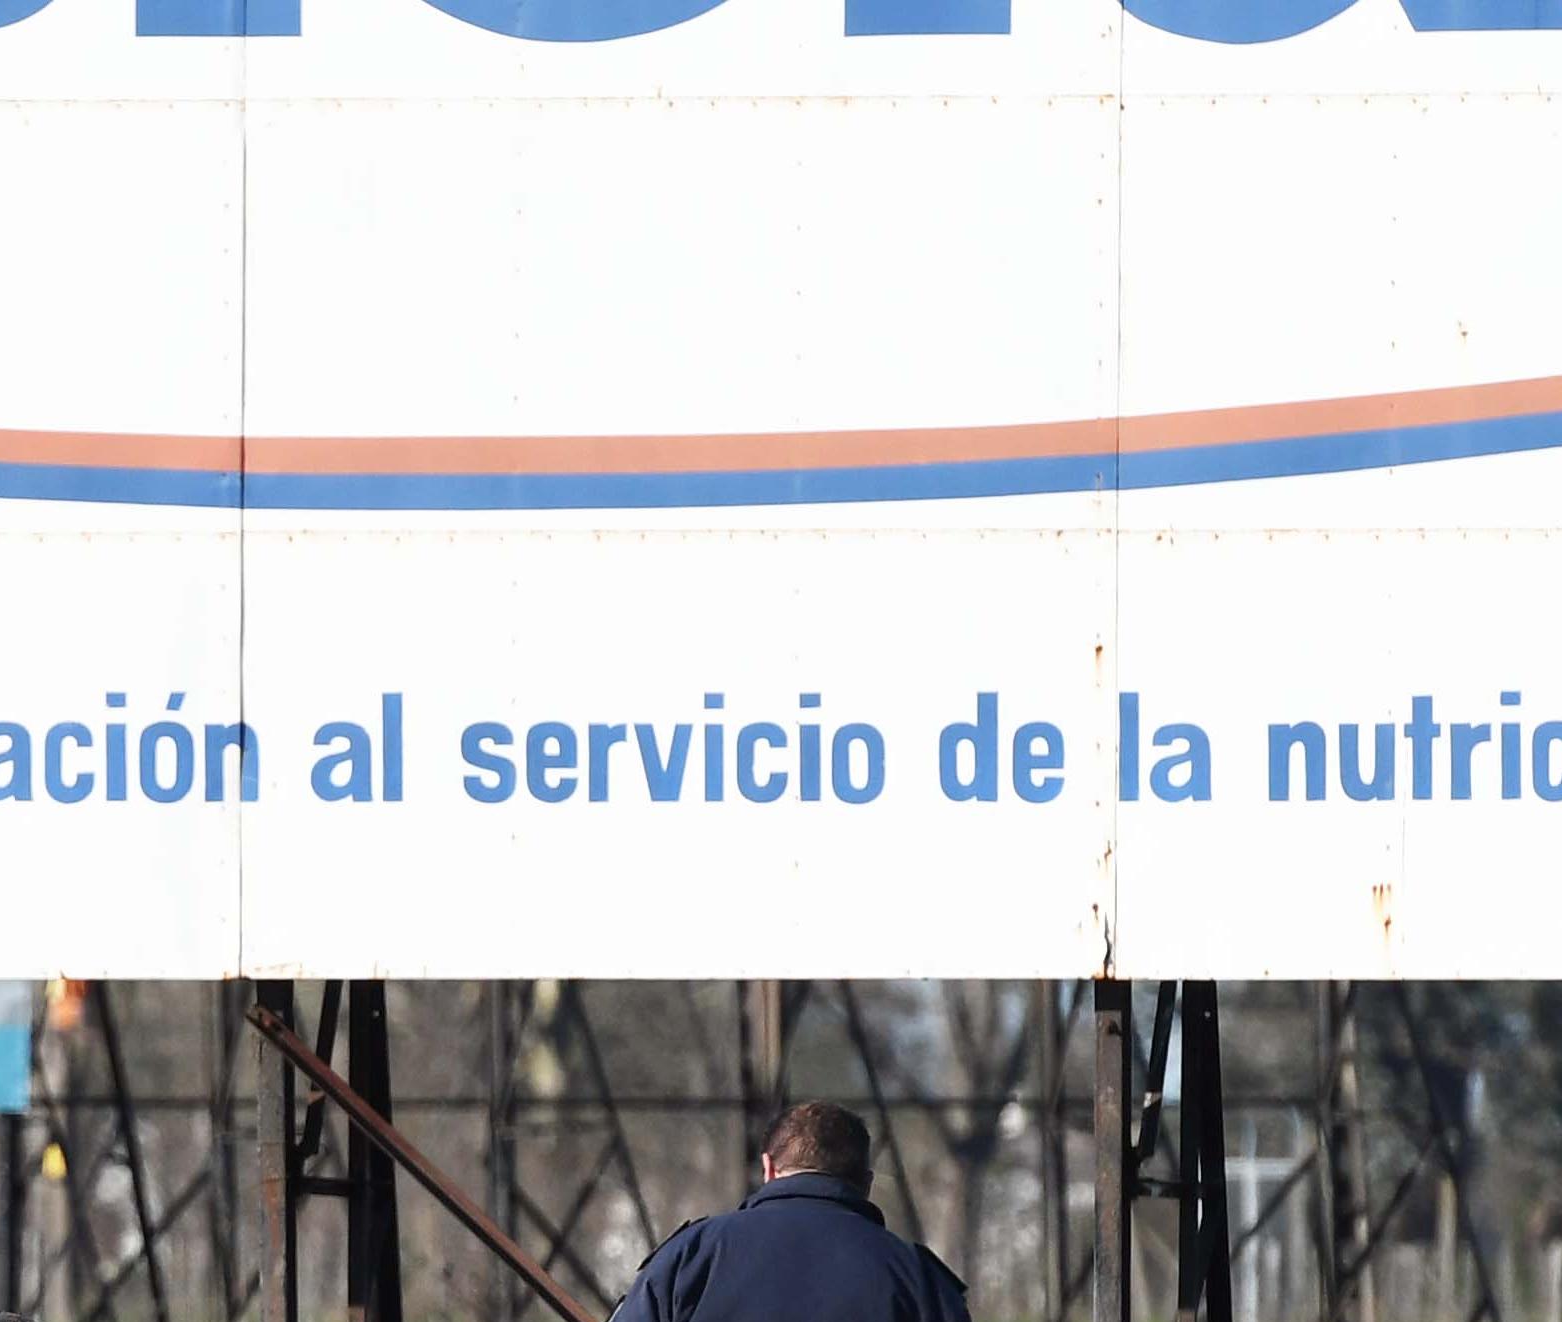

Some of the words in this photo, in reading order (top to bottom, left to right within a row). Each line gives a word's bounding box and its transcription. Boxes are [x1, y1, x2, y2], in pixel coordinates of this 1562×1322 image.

[311, 692, 403, 802] al
[462, 693, 885, 805] servicio
[939, 692, 1065, 804] de
[1119, 691, 1212, 803] la
